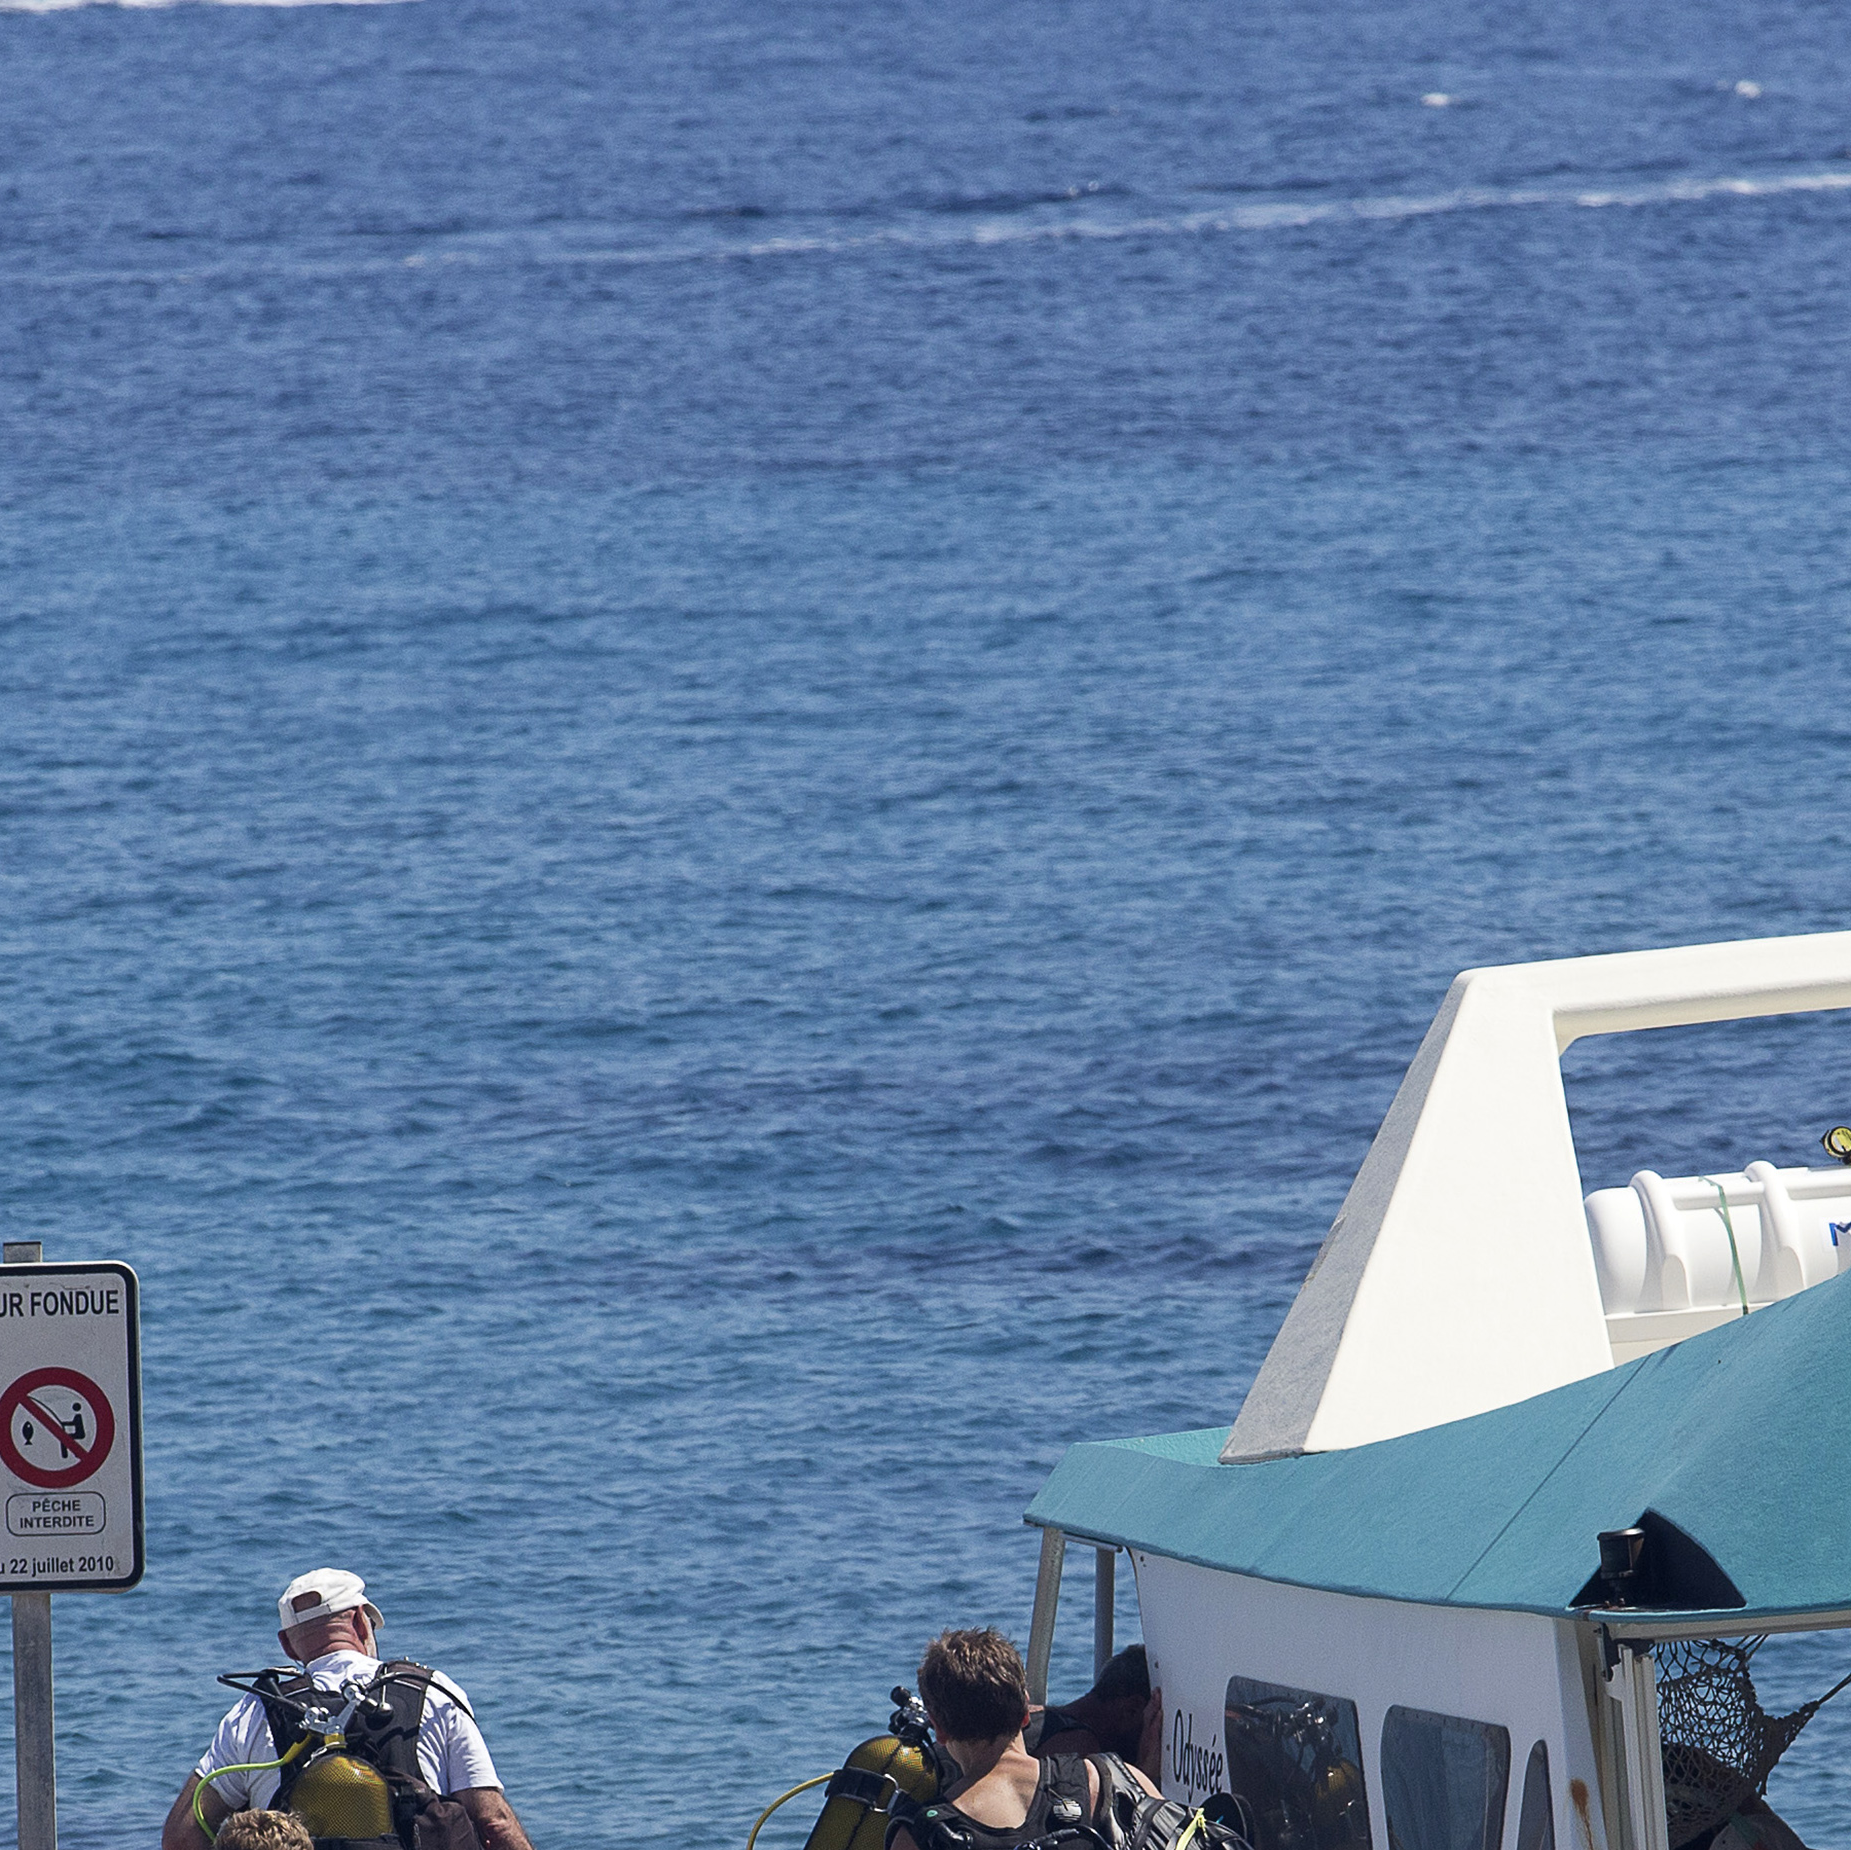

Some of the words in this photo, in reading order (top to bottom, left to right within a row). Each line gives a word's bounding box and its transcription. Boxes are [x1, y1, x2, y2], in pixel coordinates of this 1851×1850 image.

[30, 1289, 120, 1316] FONDUE
[32, 1497, 81, 1513] PÊCHE
[19, 1514, 95, 1529] INTERDITE
[10, 1558, 29, 1574] 22
[31, 1556, 75, 1578] juillet
[78, 1555, 115, 1573] 2010
[1172, 1708, 1224, 1805] Odyssée
